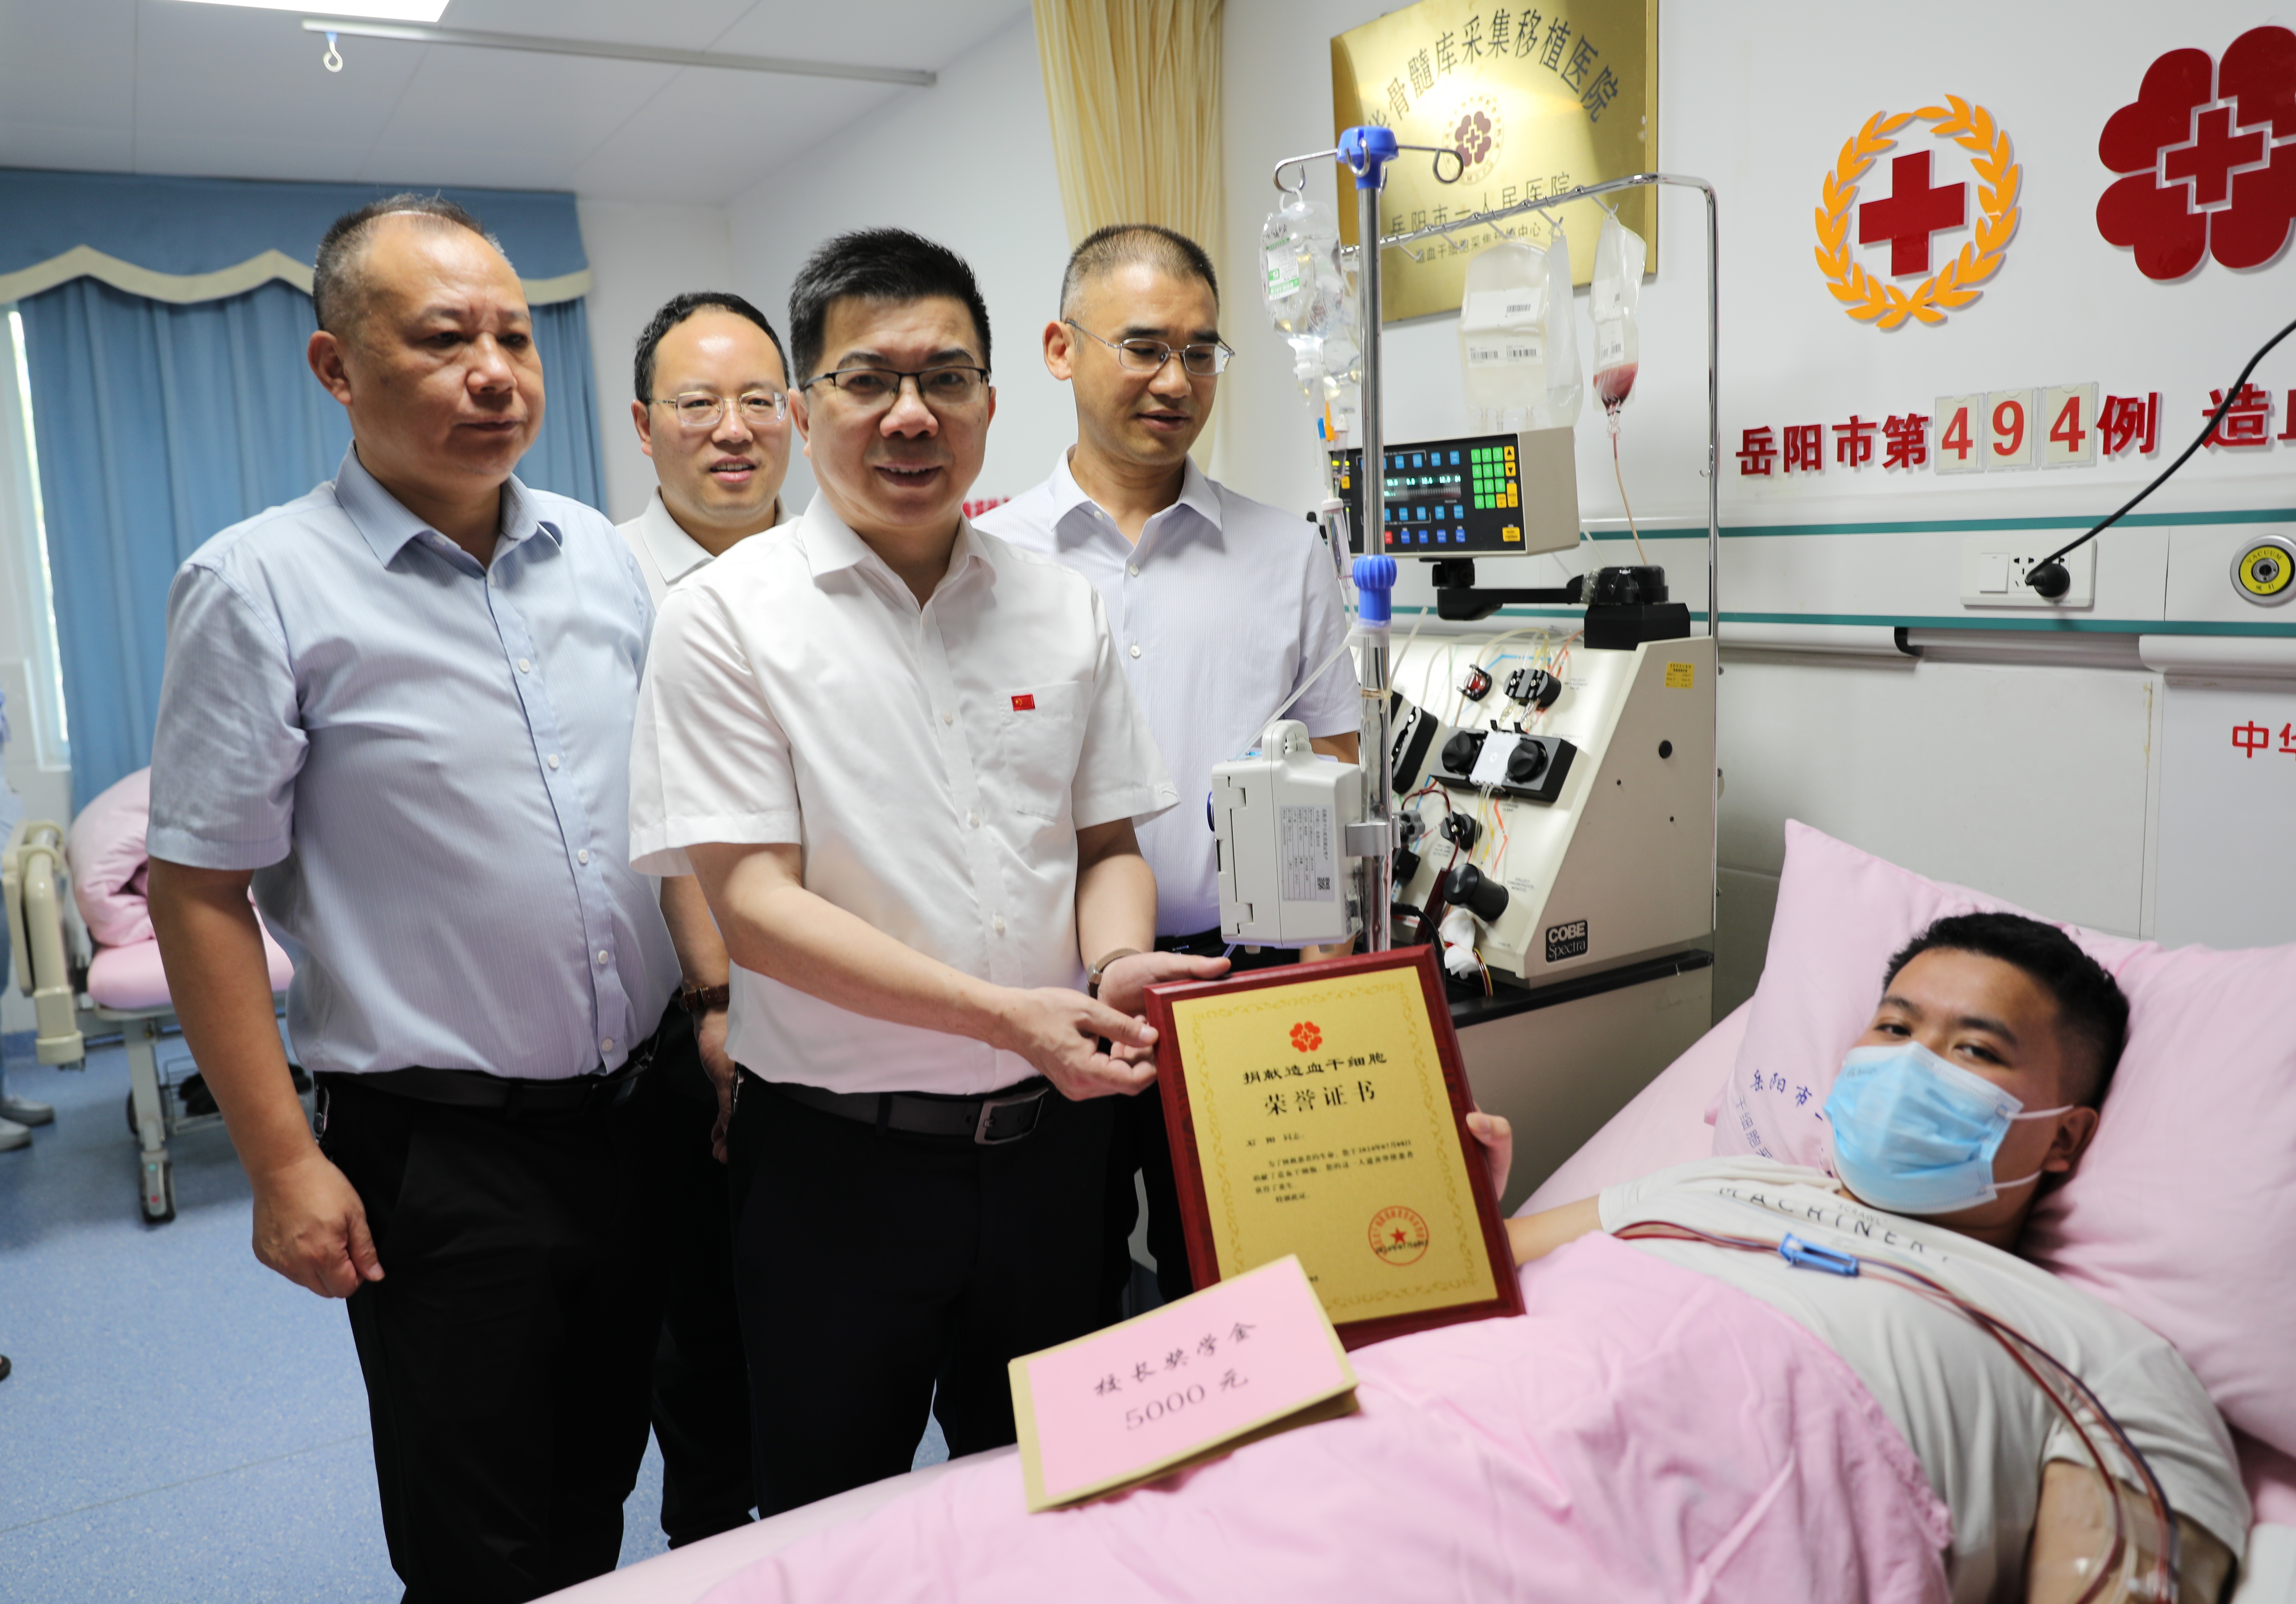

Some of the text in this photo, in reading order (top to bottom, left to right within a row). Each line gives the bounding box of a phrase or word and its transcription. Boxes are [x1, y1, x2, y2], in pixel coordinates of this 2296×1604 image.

[2201, 383, 2296, 449] 造
[2247, 550, 2282, 564] VACUUM
[1548, 921, 1586, 944] COBE
[1548, 940, 1586, 960] Spectra
[1243, 1052, 1387, 1085] 捐献造血干细胞
[1264, 1080, 1375, 1116] 荣誉证书
[1719, 1188, 1948, 1262] MACHINER
[1094, 1322, 1256, 1396] 校长奖学金
[1125, 1368, 1248, 1430] 5000 元
